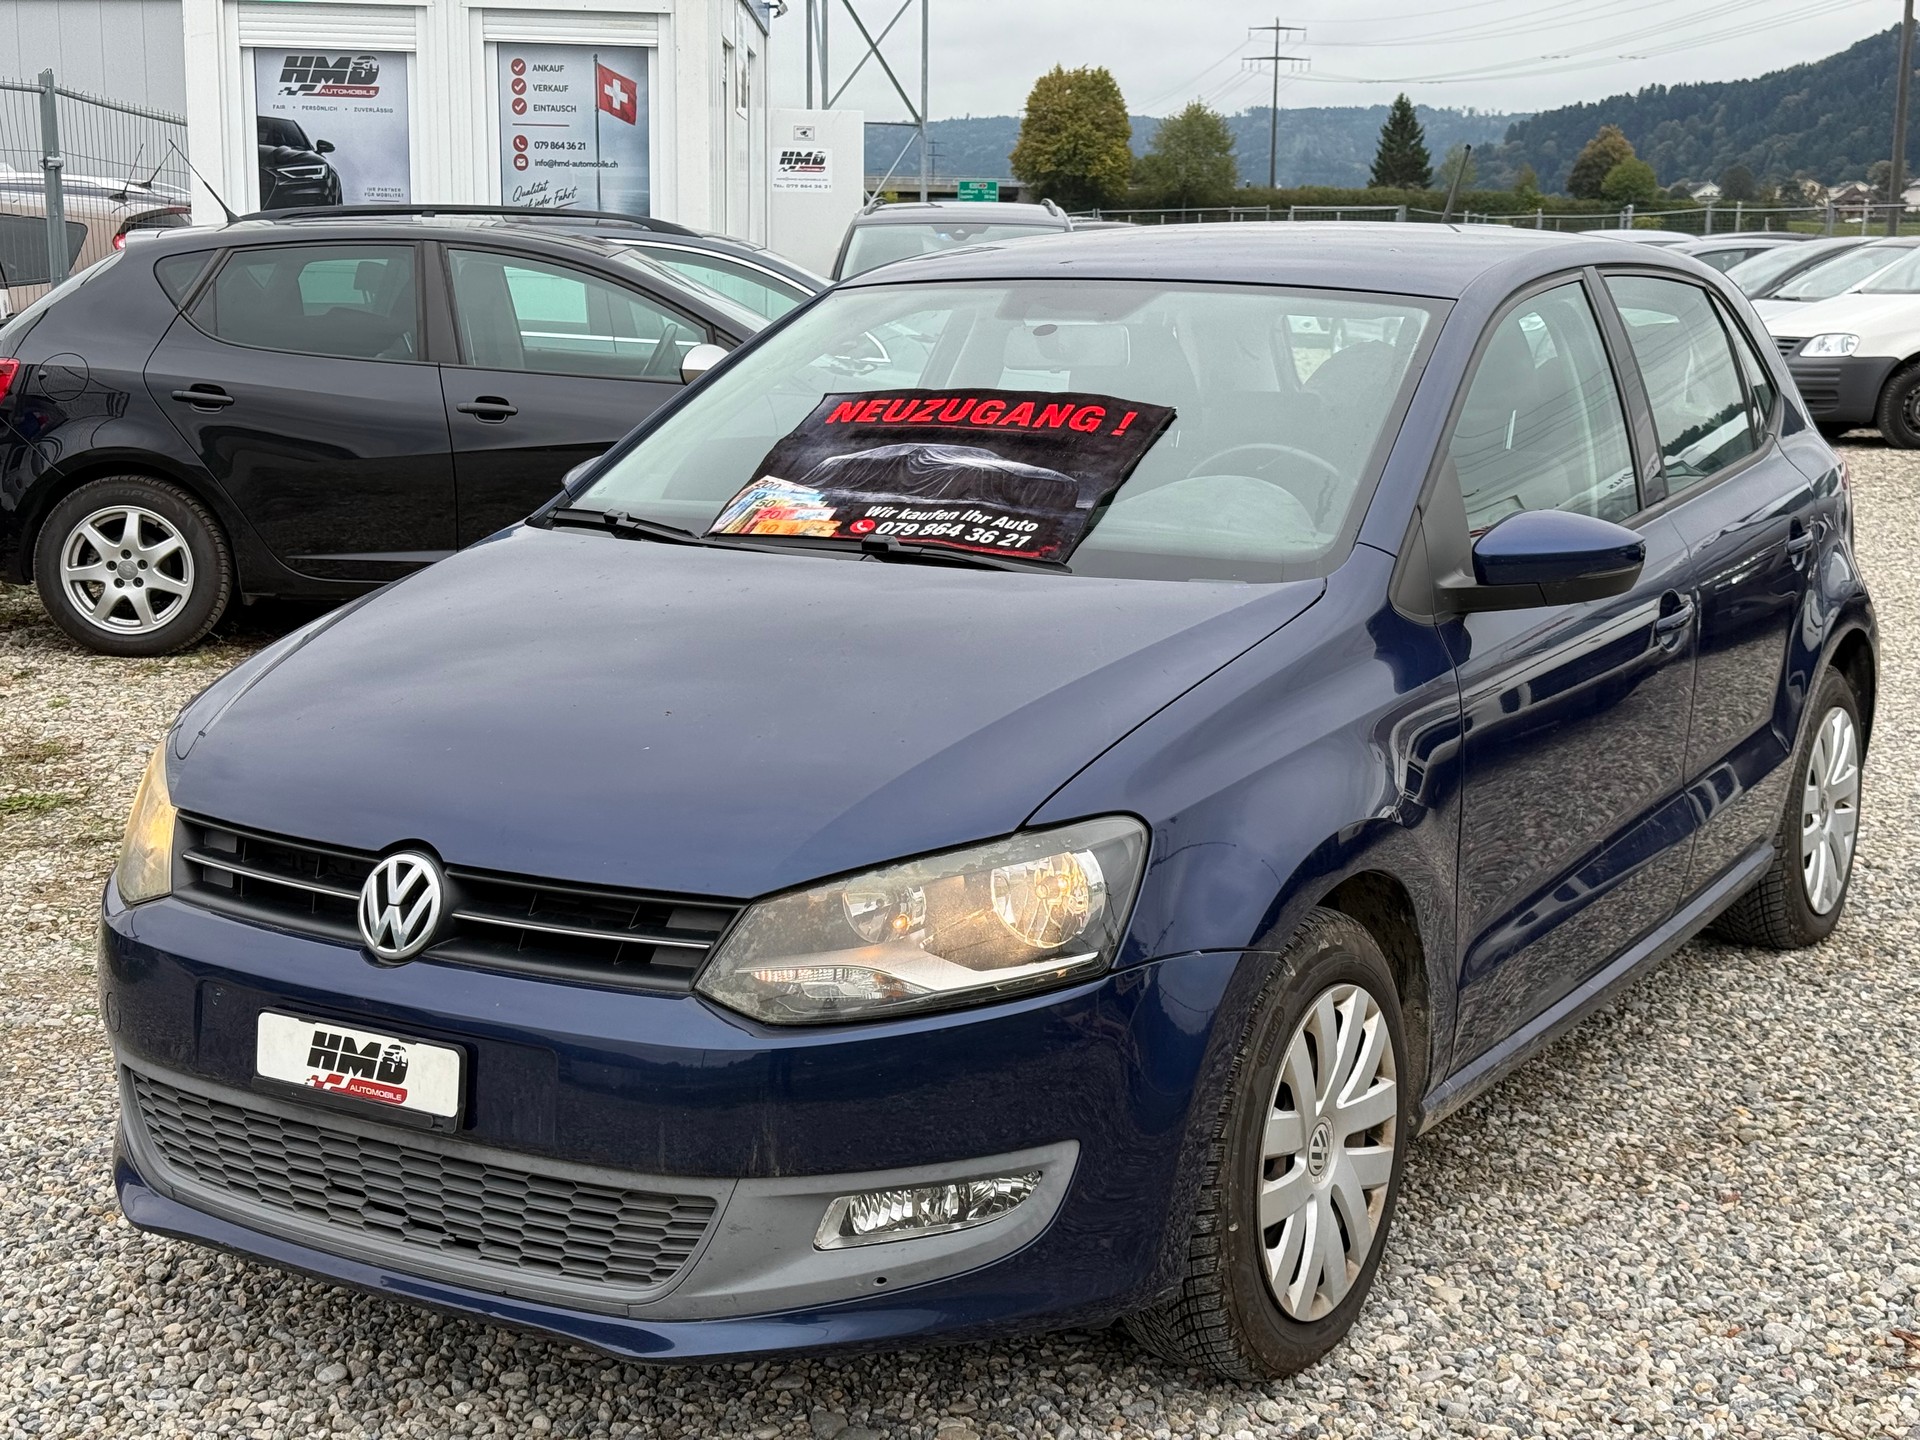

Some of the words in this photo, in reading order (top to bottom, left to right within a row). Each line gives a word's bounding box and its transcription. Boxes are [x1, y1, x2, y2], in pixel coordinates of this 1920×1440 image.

[279, 55, 380, 85] HMD
[532, 64, 565, 72] ANKAUF
[320, 88, 376, 96] AUTOMOBILE
[532, 84, 569, 92] VERKAUF
[533, 104, 577, 112] EINTAUSCH
[534, 141, 549, 149] 079
[550, 141, 565, 150] 864
[566, 142, 576, 150] 36
[577, 142, 586, 150] 21
[534, 159, 619, 168] info@hmd-automobile.ch
[825, 398, 1106, 433] NEUZUGANG
[1110, 411, 1138, 436] !
[755, 480, 782, 490] 200
[755, 499, 777, 507] 50
[758, 510, 781, 519] 20
[864, 506, 899, 518] Wir
[897, 508, 960, 521] kaufen
[959, 509, 993, 524] Ihr
[990, 516, 1039, 532] Auto
[761, 524, 779, 533] 10
[875, 521, 921, 536] 079
[918, 523, 966, 537] 864
[964, 527, 1000, 544] 36
[996, 534, 1032, 548] 21
[361, 856, 440, 957] VW
[306, 1030, 409, 1085] HMD
[350, 1083, 402, 1102] AUTOMOBILE
